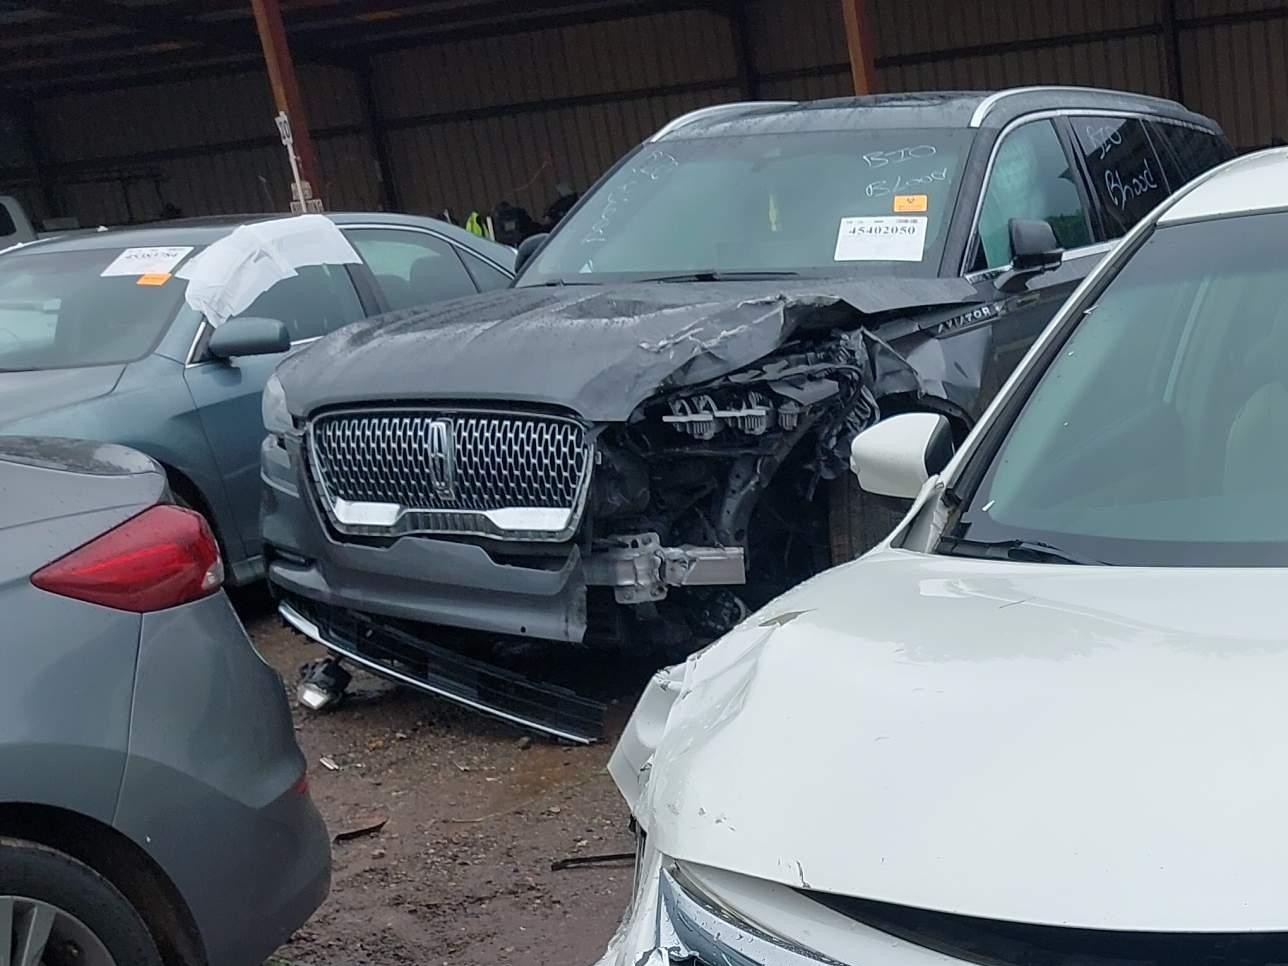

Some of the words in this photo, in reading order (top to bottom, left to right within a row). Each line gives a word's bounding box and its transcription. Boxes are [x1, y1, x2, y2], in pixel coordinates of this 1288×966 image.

[862, 145, 937, 168] BIO
[848, 225, 916, 236] 45402050
[937, 306, 991, 334] AVIATOR
